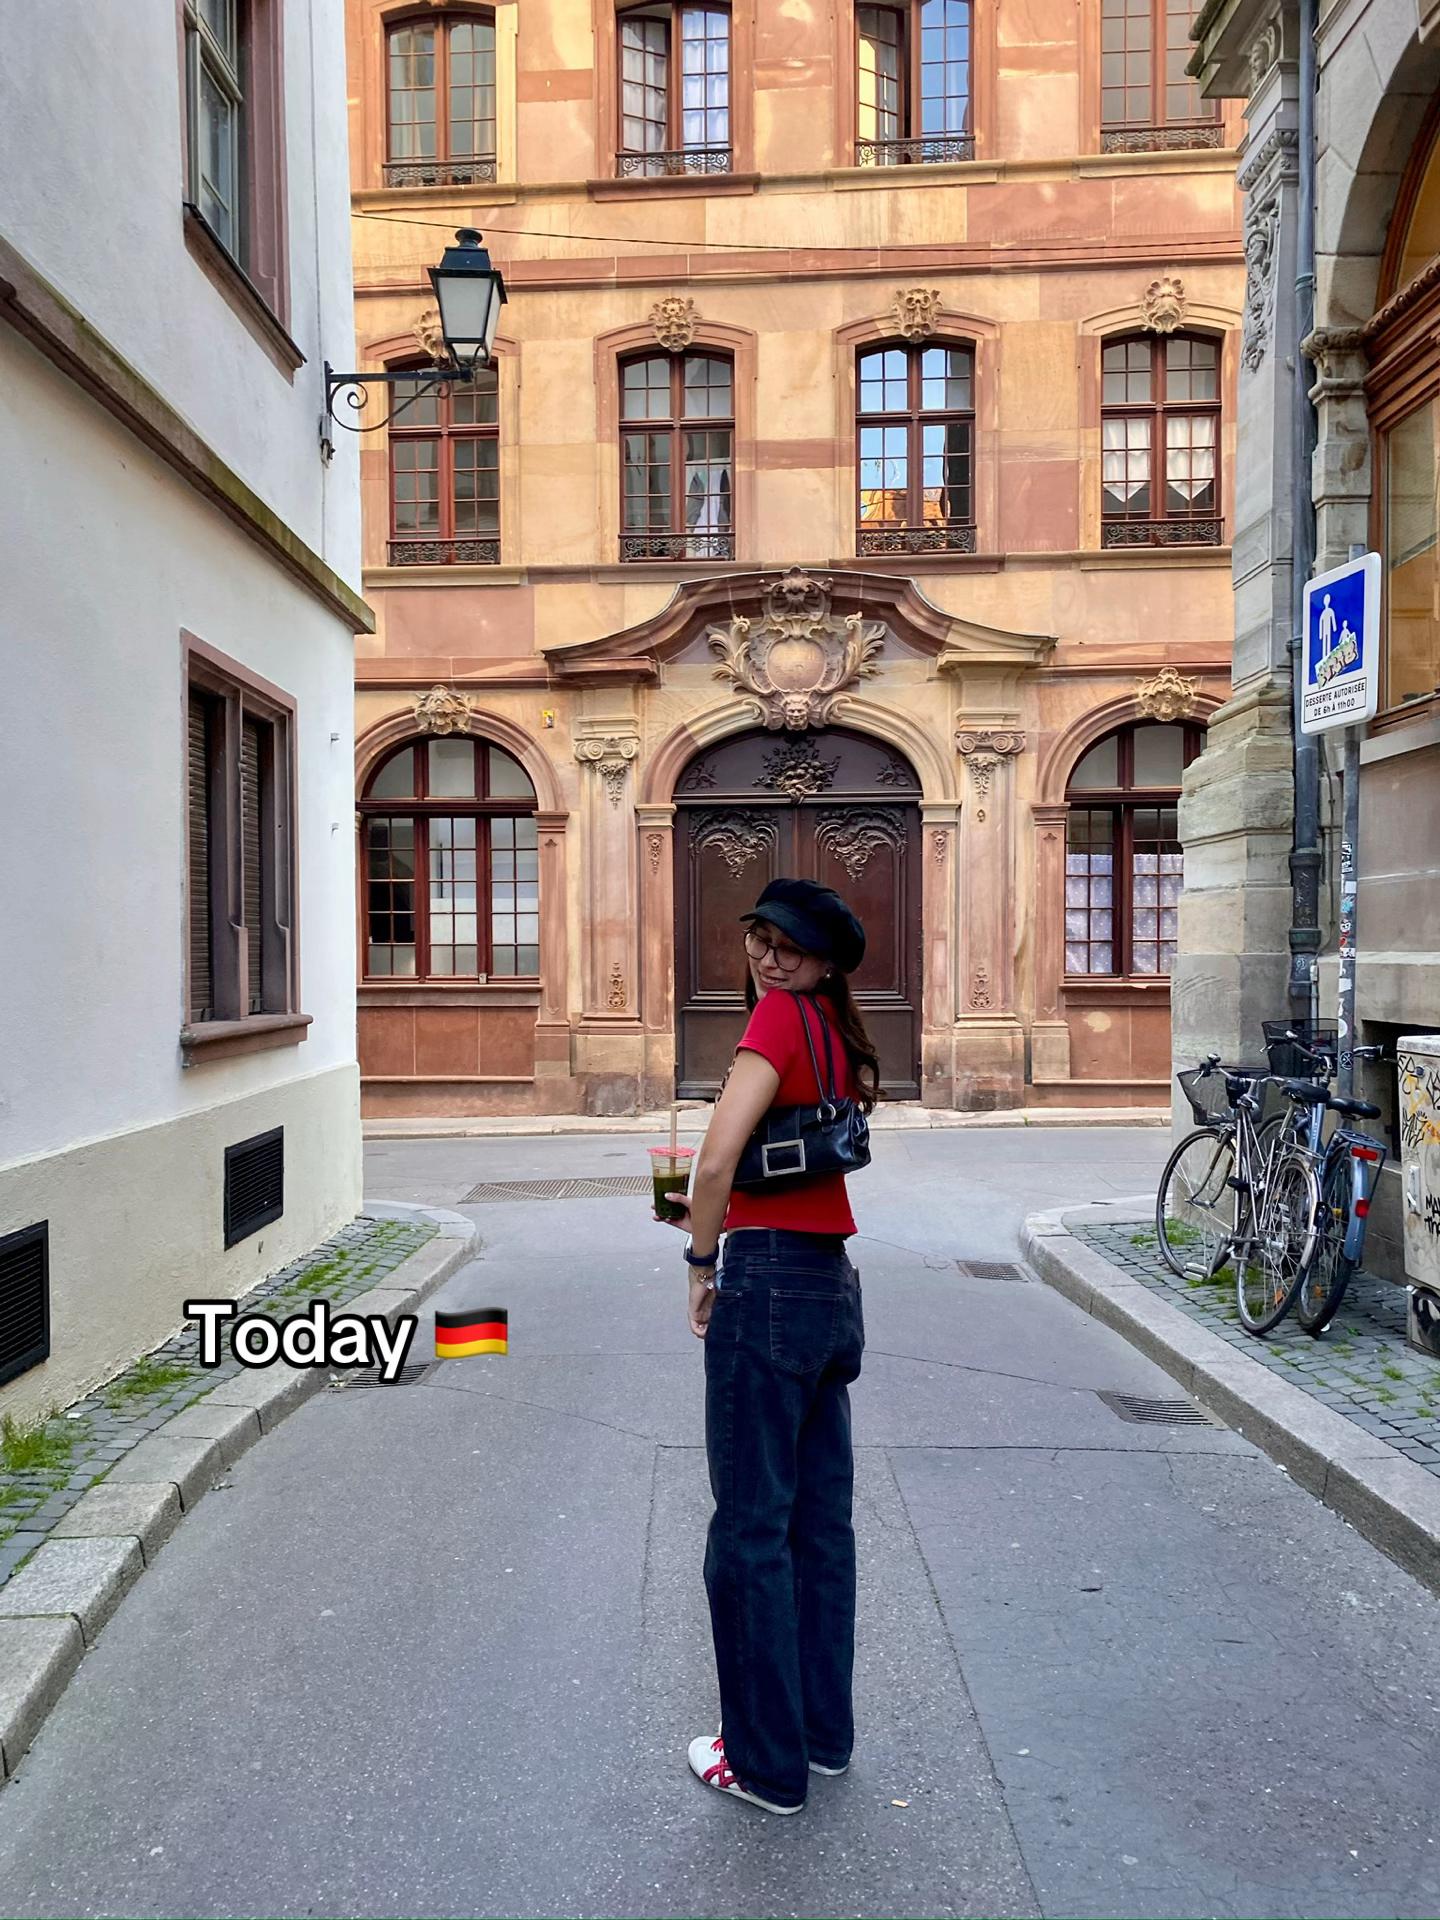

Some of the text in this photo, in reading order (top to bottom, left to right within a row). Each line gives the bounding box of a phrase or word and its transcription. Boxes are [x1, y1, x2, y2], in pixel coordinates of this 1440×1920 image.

[1305, 682, 1365, 707] DESSERTE AUTORISÉE
[1314, 707, 1321, 716] DE
[1323, 704, 1331, 713] 6h
